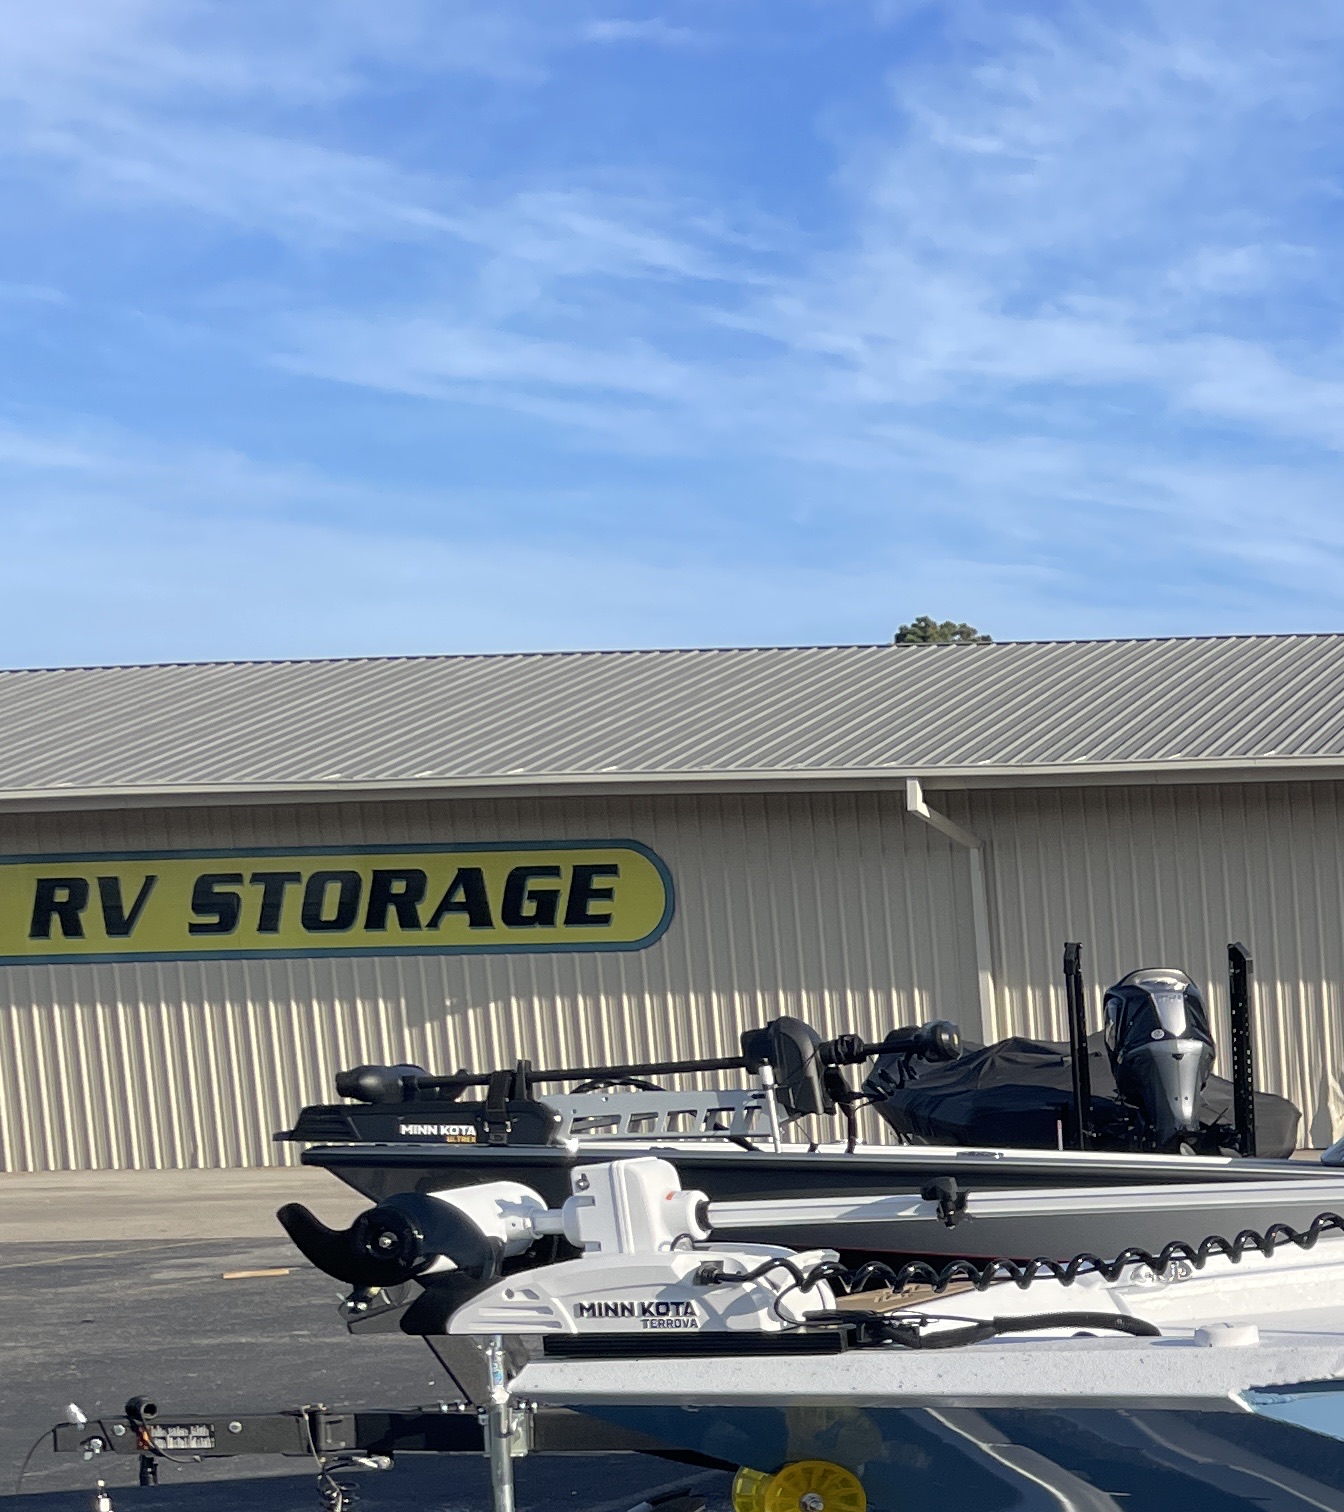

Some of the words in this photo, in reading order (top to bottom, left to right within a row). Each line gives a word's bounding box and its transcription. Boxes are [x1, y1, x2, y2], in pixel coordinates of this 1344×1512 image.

[28, 875, 157, 939] RV
[187, 864, 619, 934] STORAGE
[400, 1124, 438, 1135] MINN
[440, 1124, 477, 1136] KOTA
[574, 1301, 637, 1318] MINN
[640, 1301, 698, 1317] KOTA
[641, 1318, 699, 1329] TERROVA
